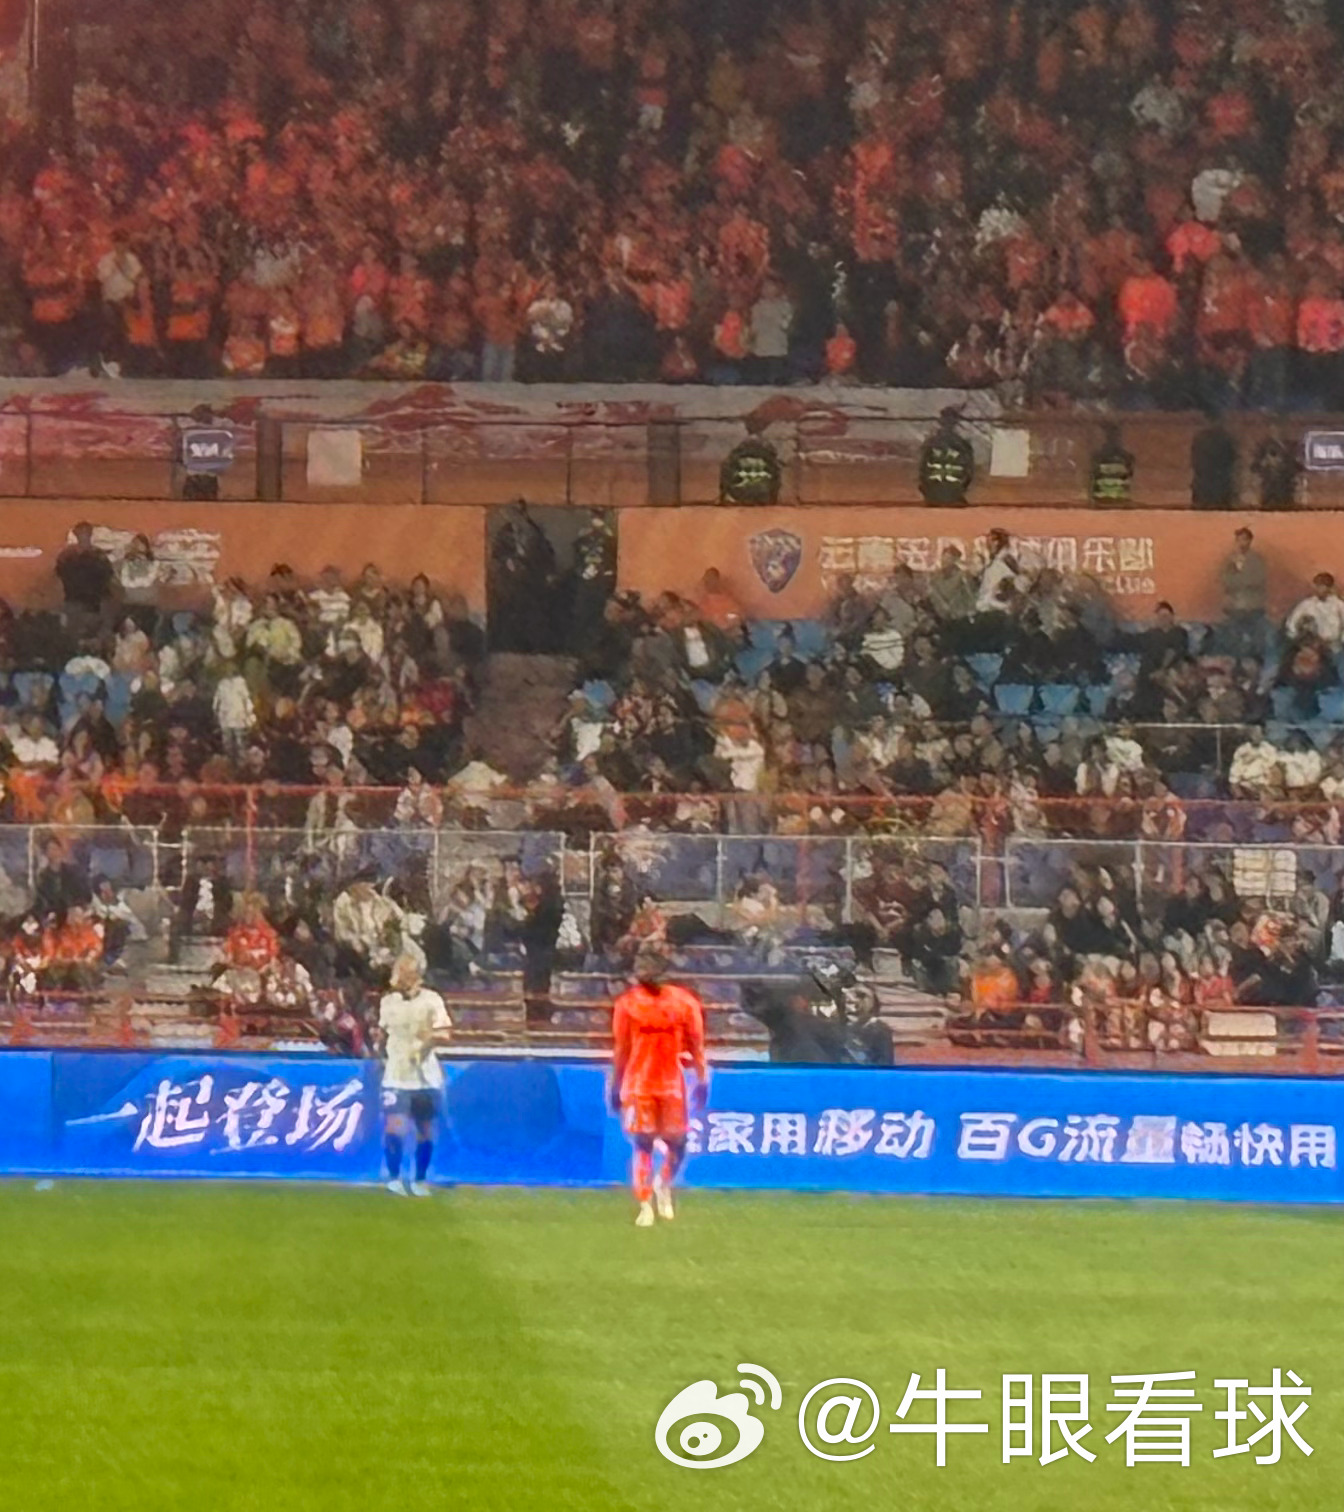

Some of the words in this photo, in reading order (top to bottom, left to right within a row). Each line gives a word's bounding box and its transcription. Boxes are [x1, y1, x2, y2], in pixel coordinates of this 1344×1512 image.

[64, 1074, 364, 1153] 一起登场
[958, 1112, 1336, 1168] 百G流量畅快用
